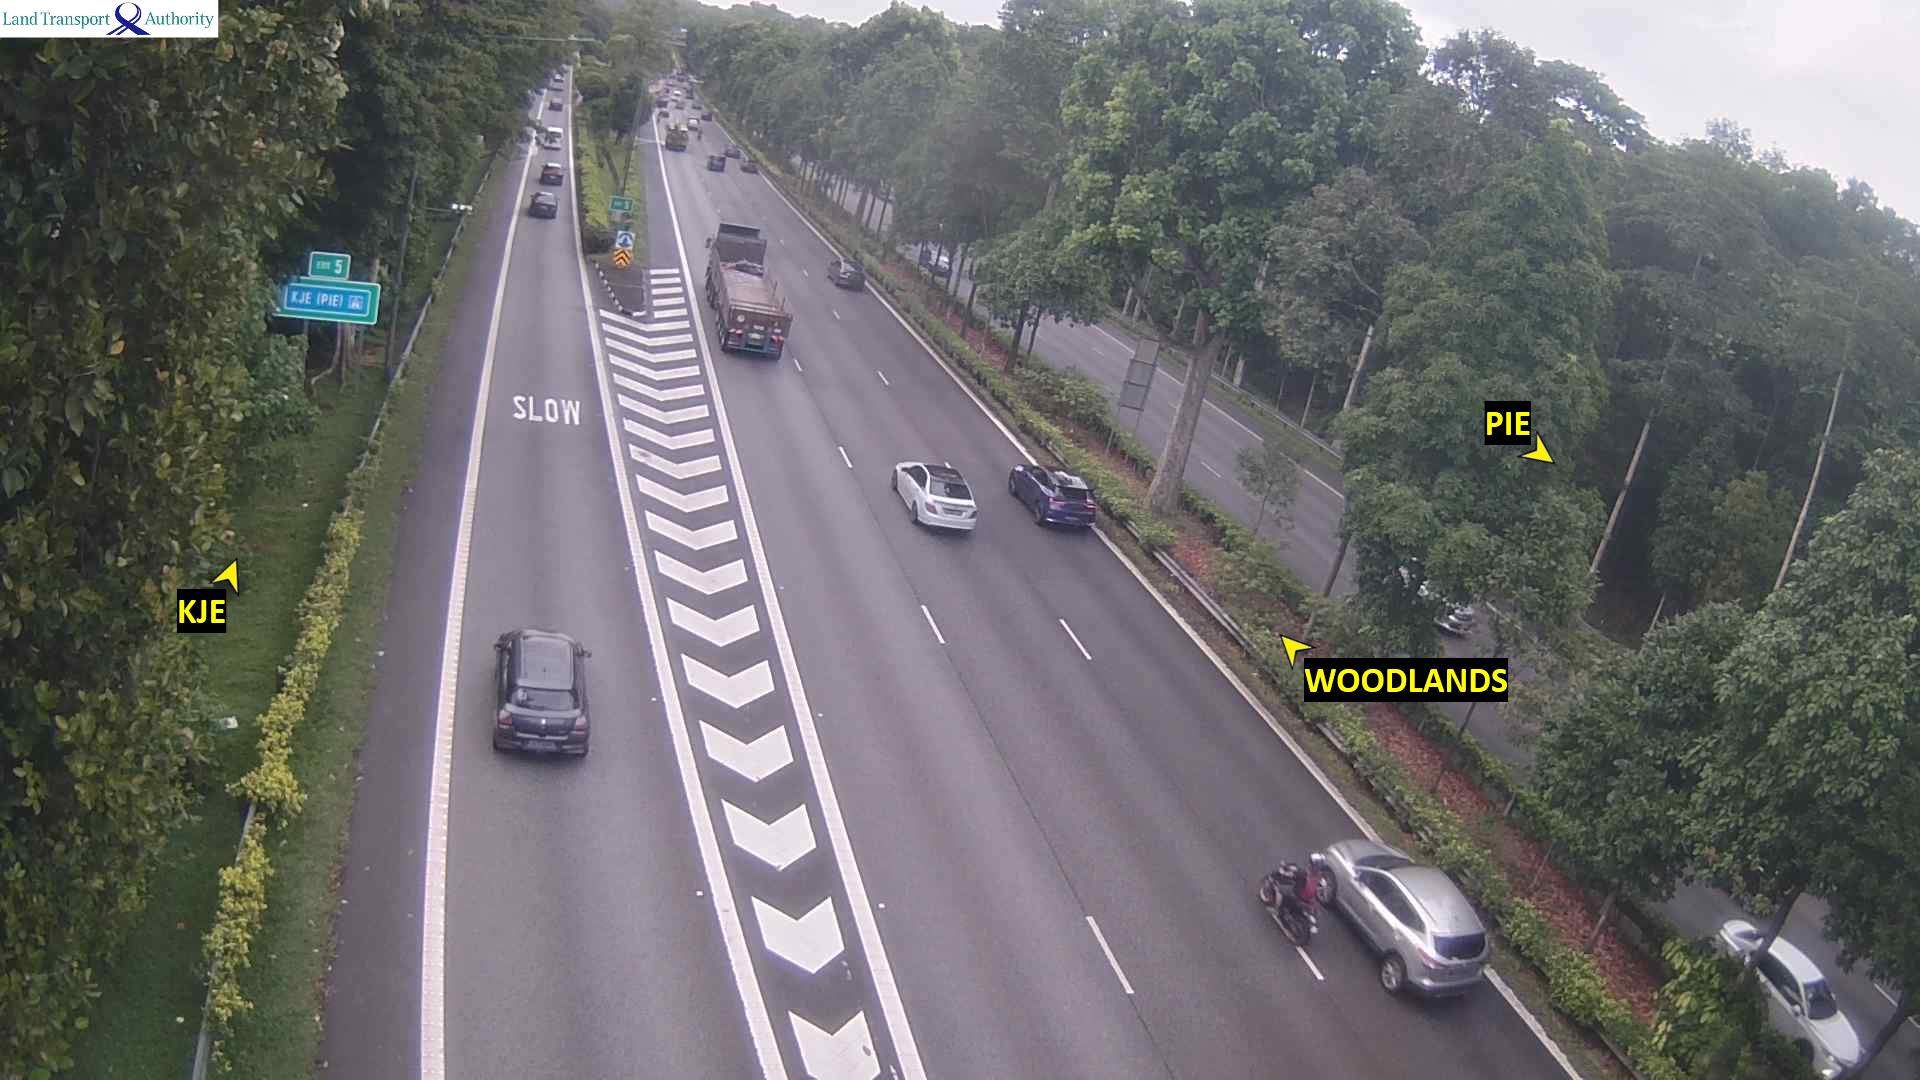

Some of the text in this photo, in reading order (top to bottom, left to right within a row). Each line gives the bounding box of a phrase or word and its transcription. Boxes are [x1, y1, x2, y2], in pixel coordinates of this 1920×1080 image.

[334, 259, 343, 274] 5
[290, 290, 344, 309] KJE (PIE)
[513, 395, 581, 425] SLOW
